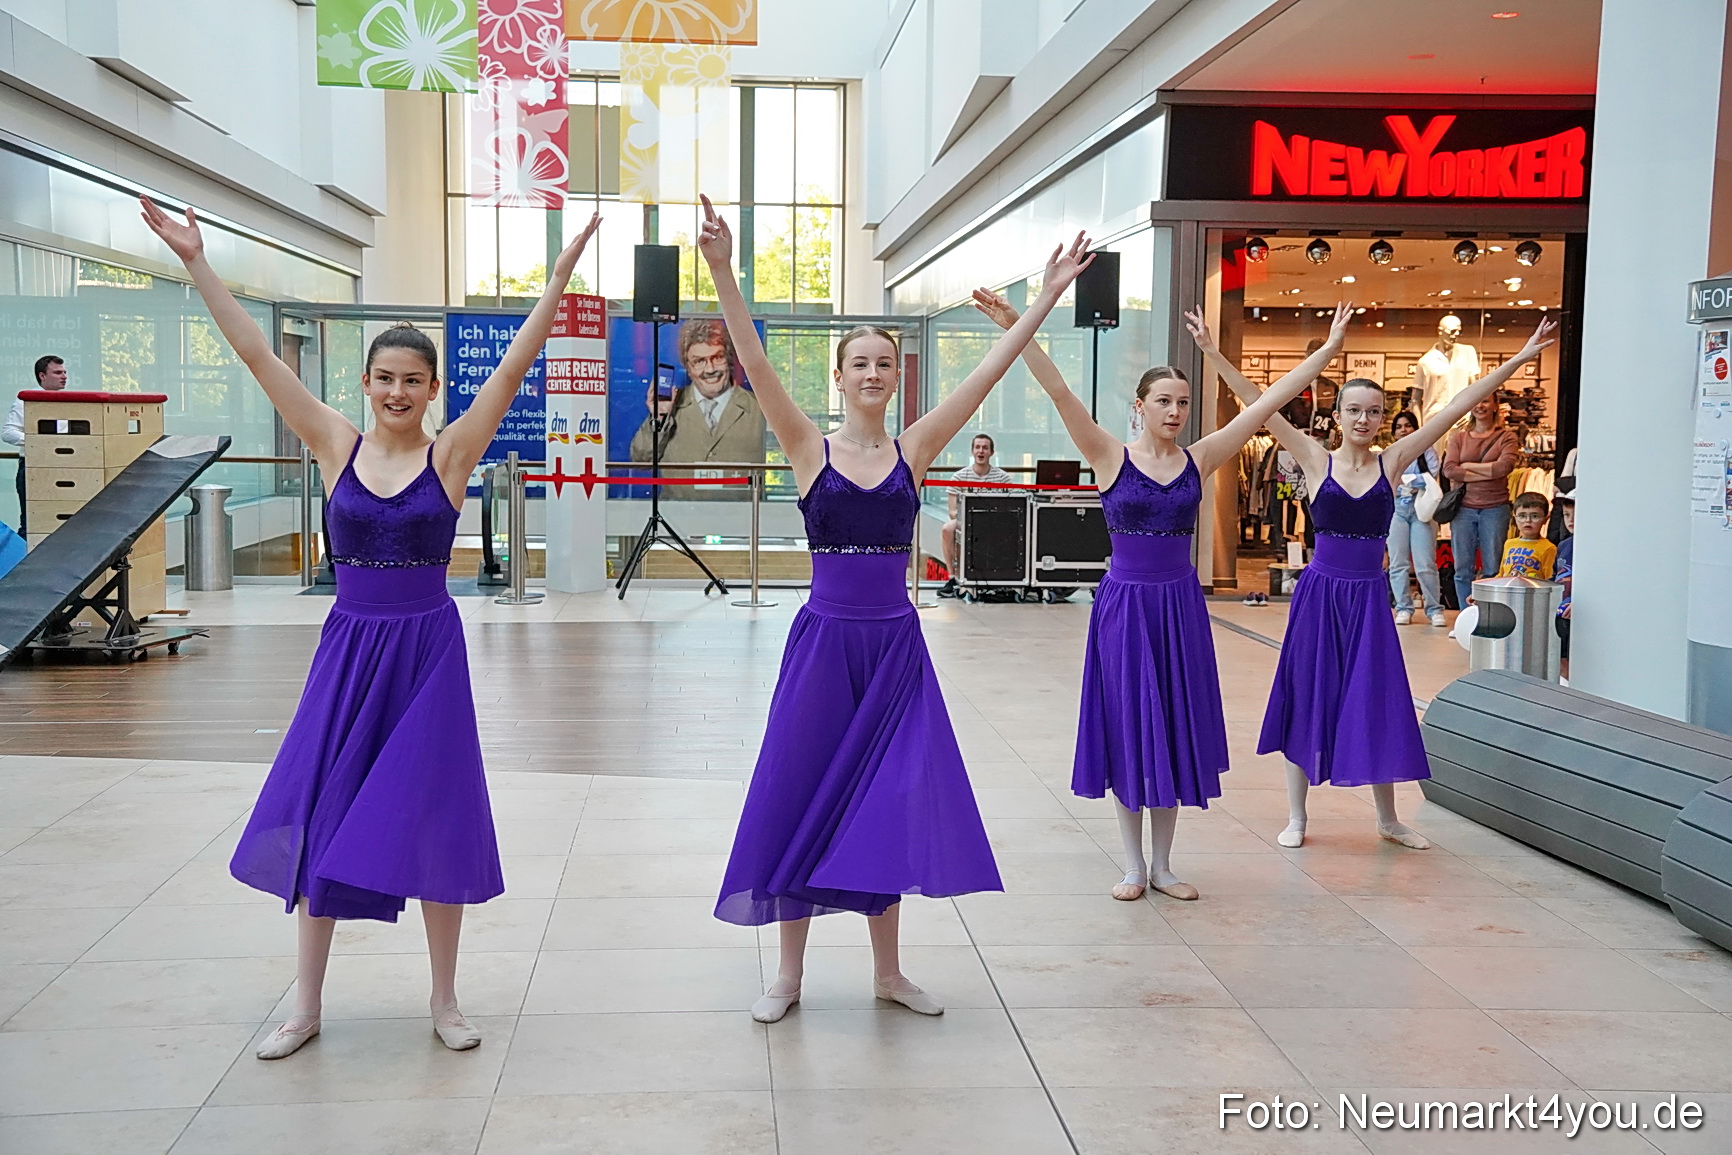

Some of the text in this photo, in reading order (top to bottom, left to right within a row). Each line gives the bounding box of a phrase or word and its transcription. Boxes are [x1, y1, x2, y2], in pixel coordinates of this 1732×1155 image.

[458, 324, 483, 340] Ich
[458, 342, 490, 358] den
[546, 360, 571, 377] REWE
[573, 361, 605, 378] REWE
[1354, 359, 1377, 368] DENIM
[458, 379, 483, 395] de
[546, 379, 571, 391] CENTER
[573, 379, 605, 392] CENTER
[506, 420, 514, 429] in
[551, 411, 568, 433] dm
[579, 412, 600, 433] dm
[1508, 547, 1535, 558] PAW
